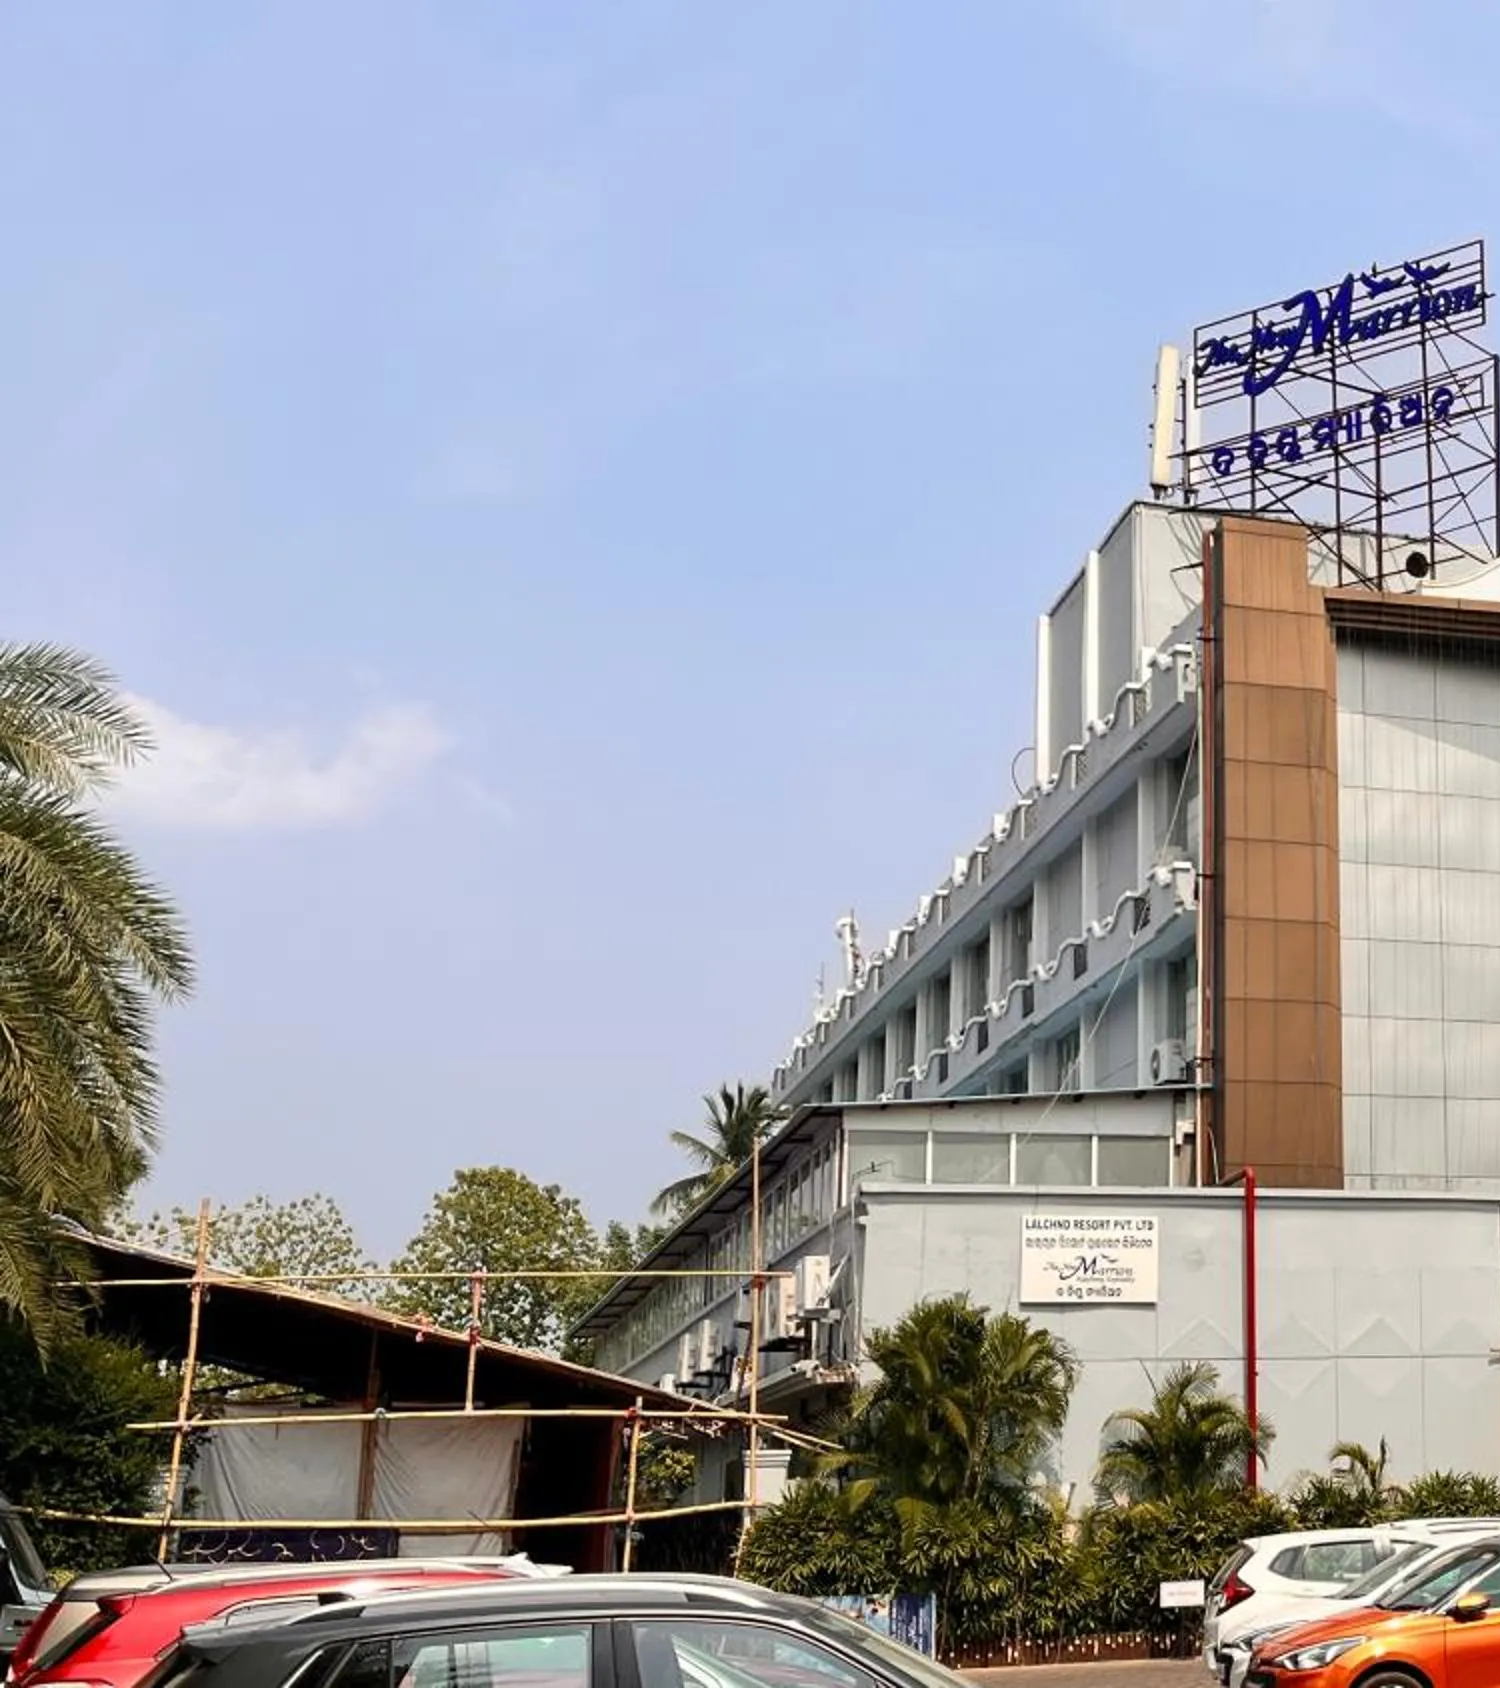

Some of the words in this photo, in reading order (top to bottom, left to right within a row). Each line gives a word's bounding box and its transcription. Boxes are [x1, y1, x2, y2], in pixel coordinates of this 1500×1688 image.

[1243, 273, 1486, 396] Marrion
[1074, 1219, 1110, 1231] RESORT
[1136, 1219, 1154, 1231] LTD
